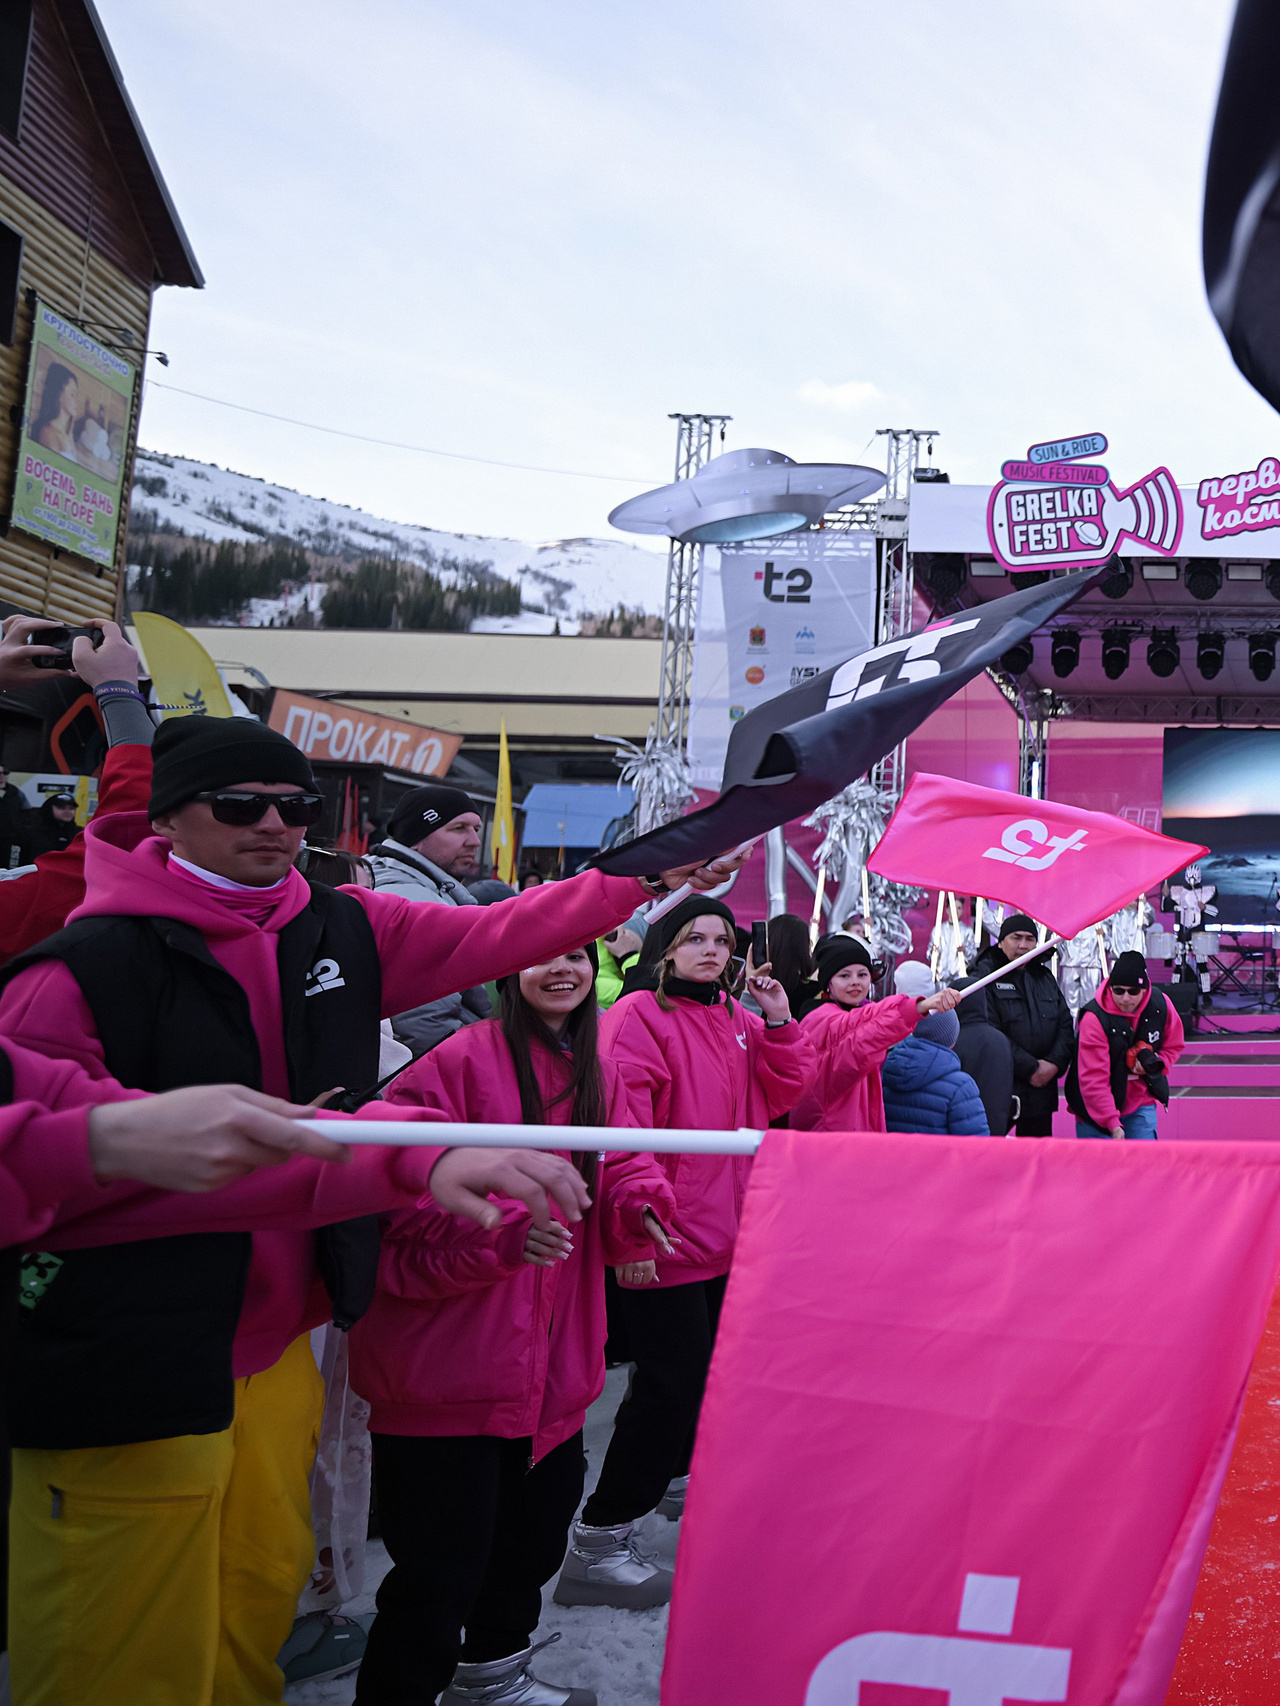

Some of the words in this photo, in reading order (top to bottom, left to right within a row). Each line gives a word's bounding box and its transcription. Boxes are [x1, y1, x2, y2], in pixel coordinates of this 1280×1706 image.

[43, 309, 130, 377] КРУГЛОСУТОЧНО
[1034, 445, 1059, 462] SUN
[1061, 444, 1071, 456] &
[1072, 437, 1099, 454] RIDE
[24, 456, 77, 497] ВОСЕМЬ
[82, 485, 114, 515] БАНЬ
[1009, 464, 1046, 480] MUSIC
[1049, 465, 1100, 483] FESTIVAL
[42, 486, 60, 510] НА
[63, 497, 94, 526] ГОРЕ
[1010, 488, 1099, 523] GRELKA
[1012, 521, 1072, 553] FEST
[760, 562, 813, 604] t2
[282, 705, 411, 767] ПРОКАТ
